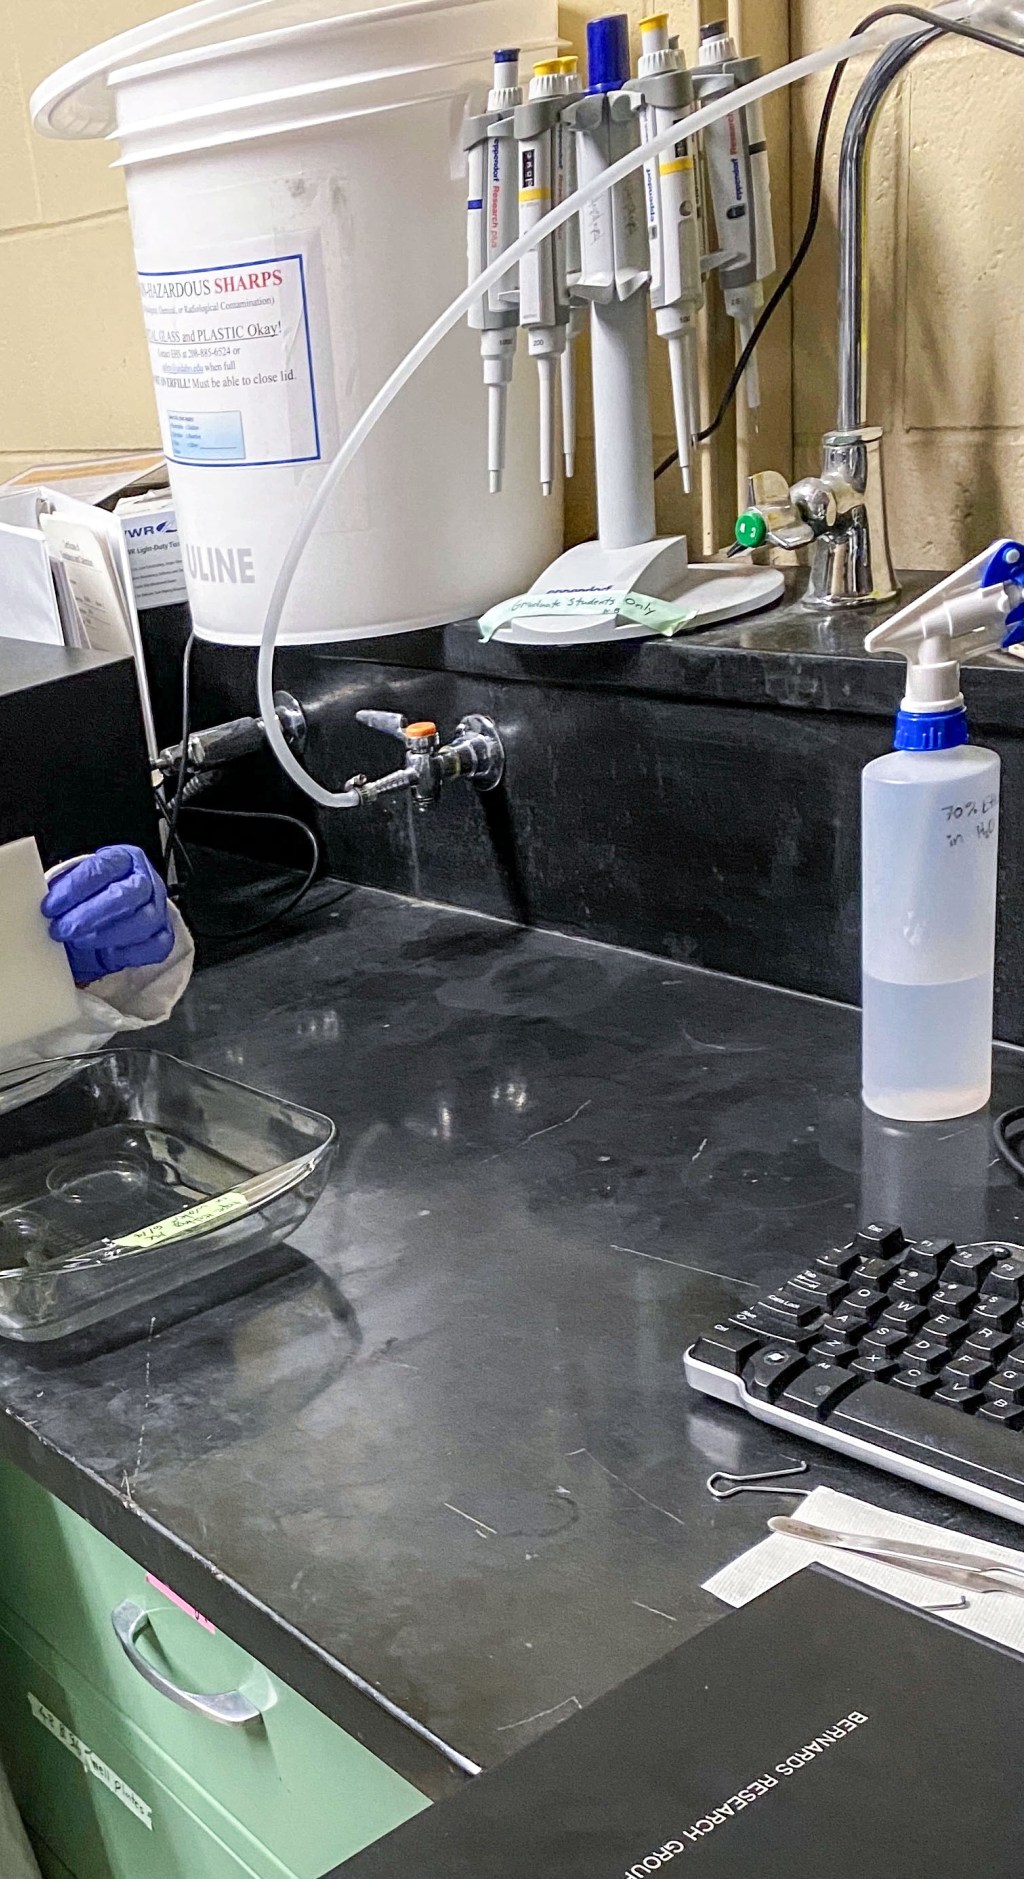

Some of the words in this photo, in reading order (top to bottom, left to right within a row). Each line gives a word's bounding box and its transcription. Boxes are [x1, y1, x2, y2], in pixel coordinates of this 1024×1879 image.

[491, 185, 500, 228] Research
[214, 269, 283, 294] SHARPS
[182, 329, 196, 343] and
[197, 325, 244, 342] PLASTIC
[247, 320, 282, 338] Okay!
[232, 347, 241, 355] or
[205, 362, 223, 372] when
[224, 361, 236, 371] full
[192, 378, 210, 389] Must
[211, 376, 221, 388] be
[222, 374, 239, 388] able
[242, 374, 252, 386] to
[253, 372, 278, 384] close
[280, 369, 297, 381] lid.
[124, 525, 155, 538] WR
[186, 543, 256, 585] ULINE
[568, 597, 616, 607] Students
[626, 597, 657, 616] Only
[941, 801, 978, 821] 70%
[946, 834, 964, 847] in
[896, 1278, 906, 1286] 2
[897, 1301, 916, 1312] W
[935, 1314, 951, 1324] E
[876, 1327, 890, 1335] S
[978, 1328, 993, 1338] R
[915, 1340, 931, 1349] D
[958, 1354, 974, 1362] F
[908, 1369, 922, 1377] C
[1003, 1370, 1017, 1379] G
[952, 1382, 968, 1390] V
[993, 1398, 1008, 1407] B
[775, 1711, 869, 1776] BERNARDS
[682, 1773, 779, 1842] RESEARCH
